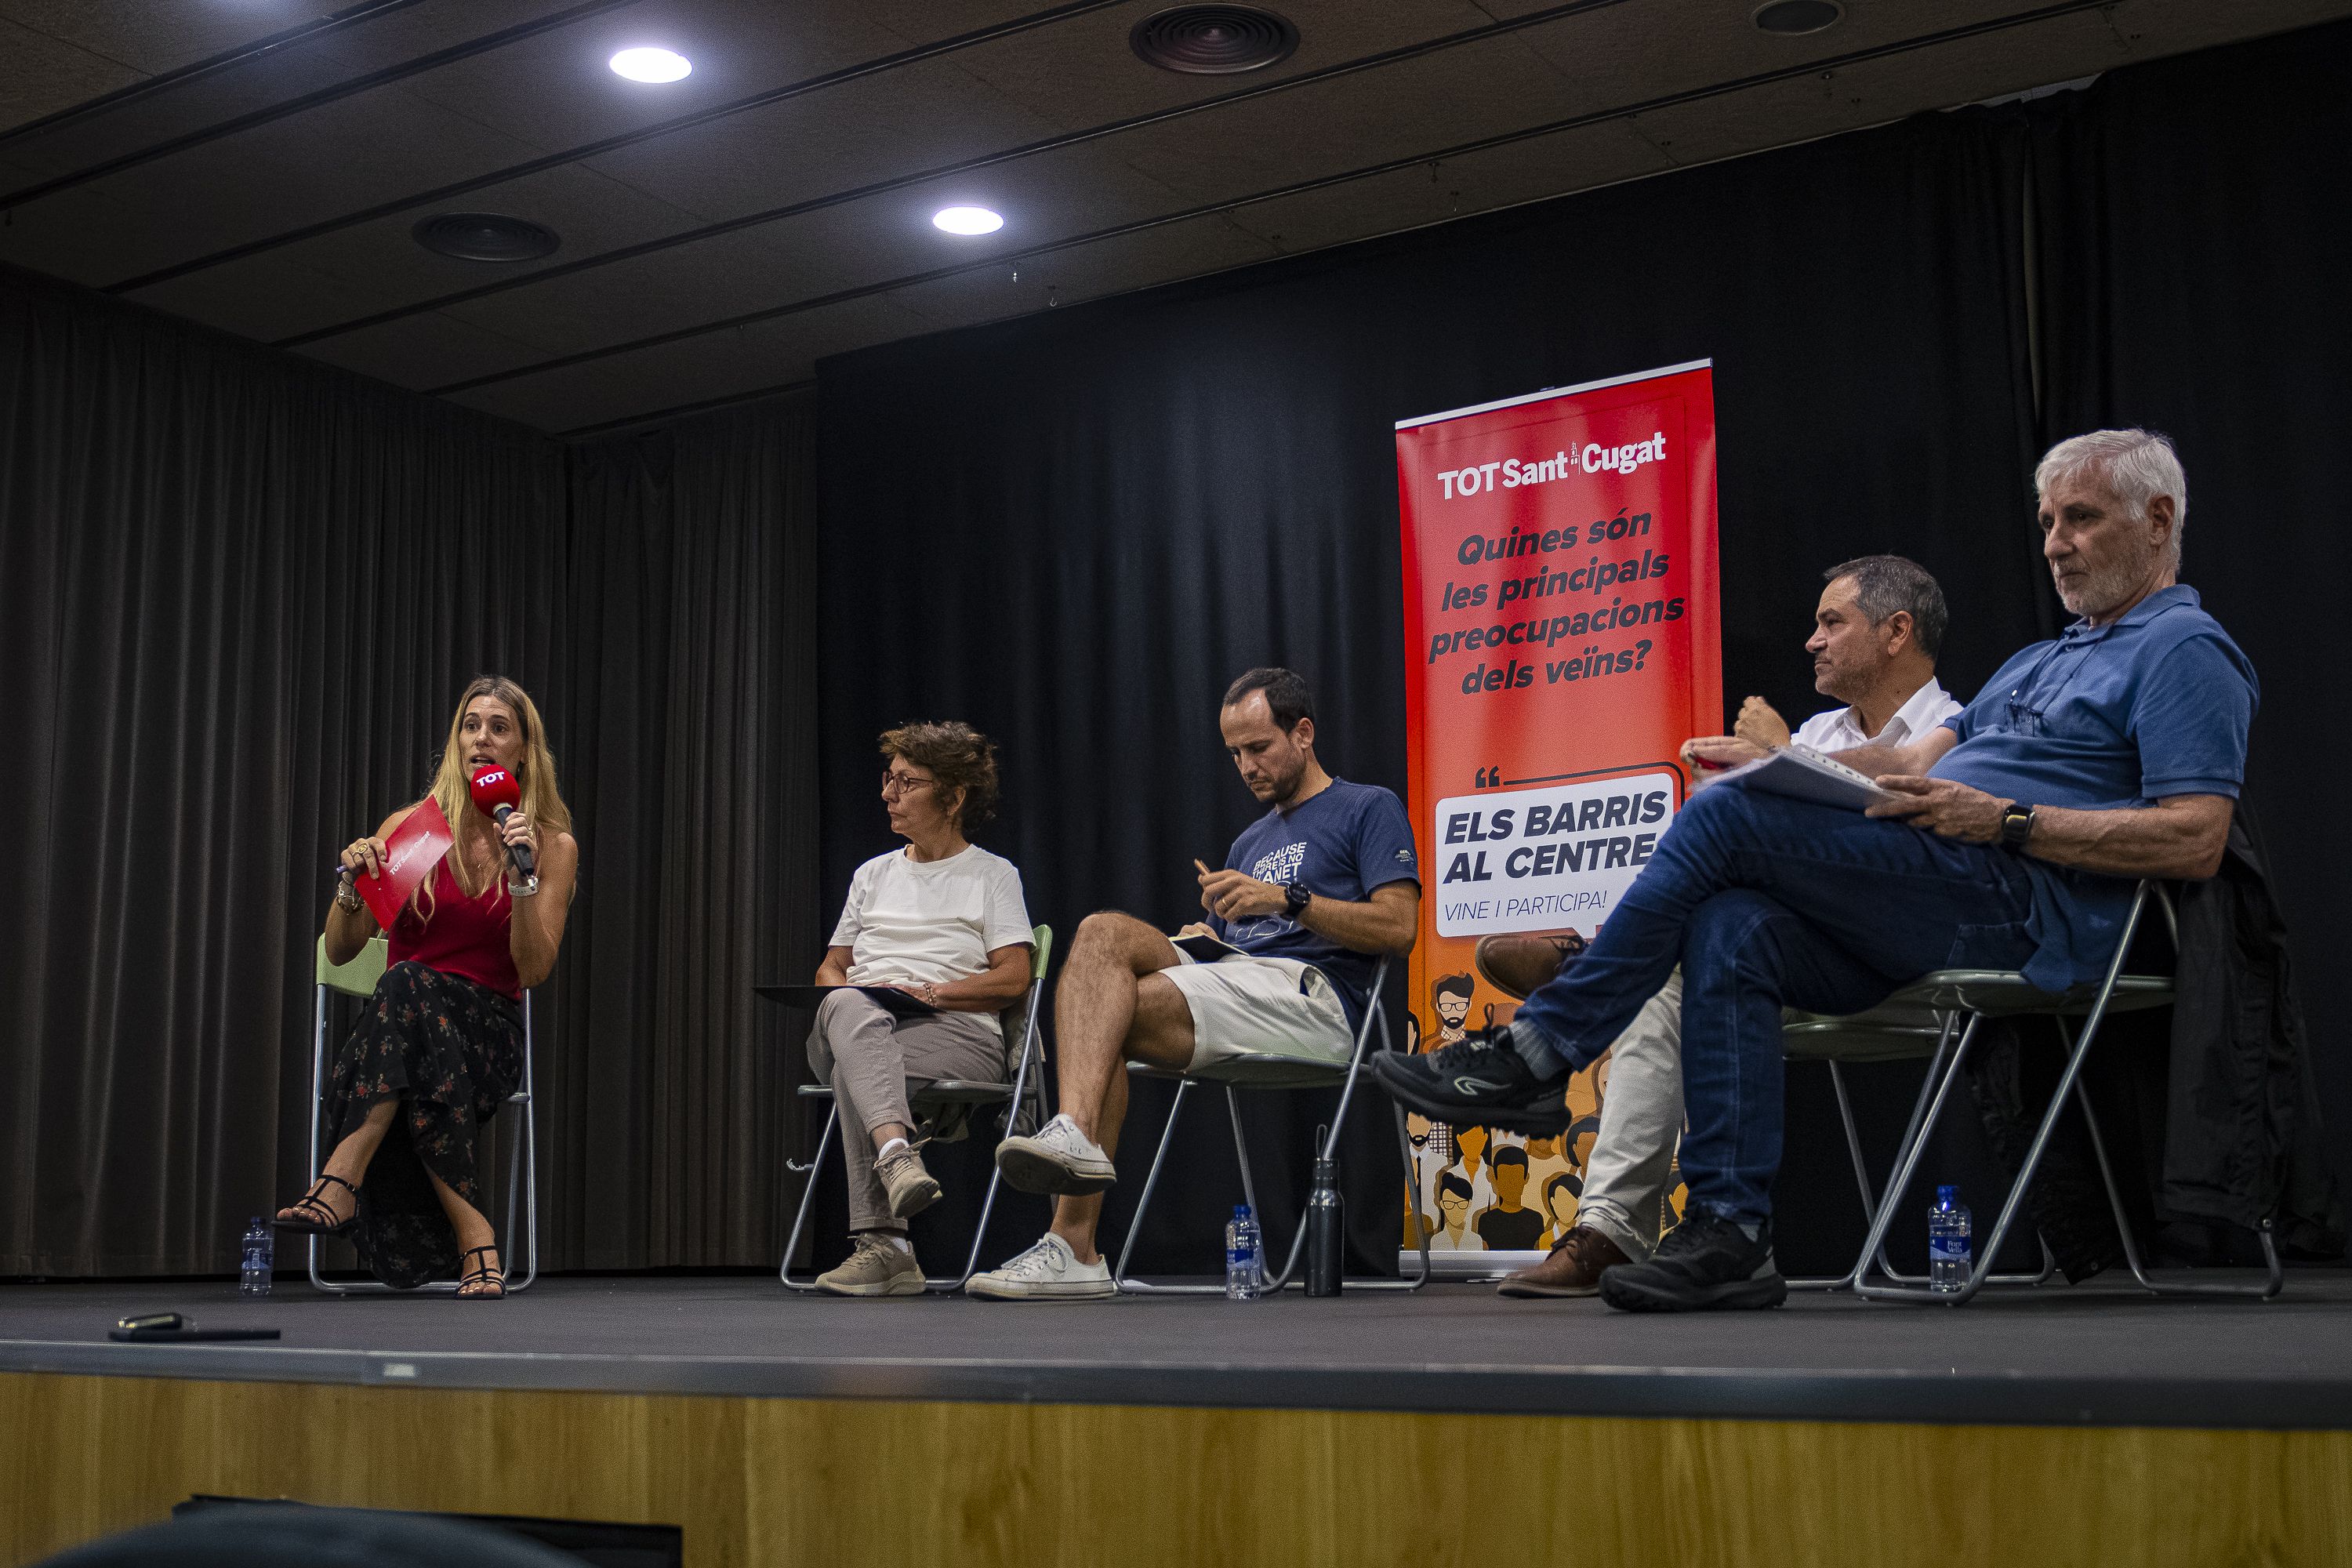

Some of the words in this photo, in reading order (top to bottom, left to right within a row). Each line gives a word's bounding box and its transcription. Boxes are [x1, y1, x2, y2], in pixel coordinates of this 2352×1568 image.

[1437, 462, 1501, 499] TOT
[1501, 452, 1568, 488] Sant
[1582, 432, 1666, 475] Cugat
[1457, 526, 1579, 565] Quines
[1587, 508, 1652, 543] són
[1441, 582, 1488, 612] les
[1497, 550, 1670, 610] principals
[1428, 597, 1685, 664] preocupacions
[1461, 659, 1534, 695] dels
[1546, 640, 1653, 684] veïns?
[476, 771, 505, 787] TOT
[1444, 808, 1515, 845] ELS
[1523, 790, 1668, 838] BARRIS
[1252, 861, 1278, 879] THERE
[1278, 857, 1286, 867] IS
[1288, 853, 1304, 862] NO
[1253, 841, 1307, 871] BECAUSE
[1258, 862, 1302, 884] ANET
[1442, 849, 1493, 884] AL
[1504, 832, 1657, 880] CENTRE
[1444, 900, 1490, 921] VINE
[1495, 900, 1501, 917] I
[1505, 890, 1608, 916] PARTICIPA!
